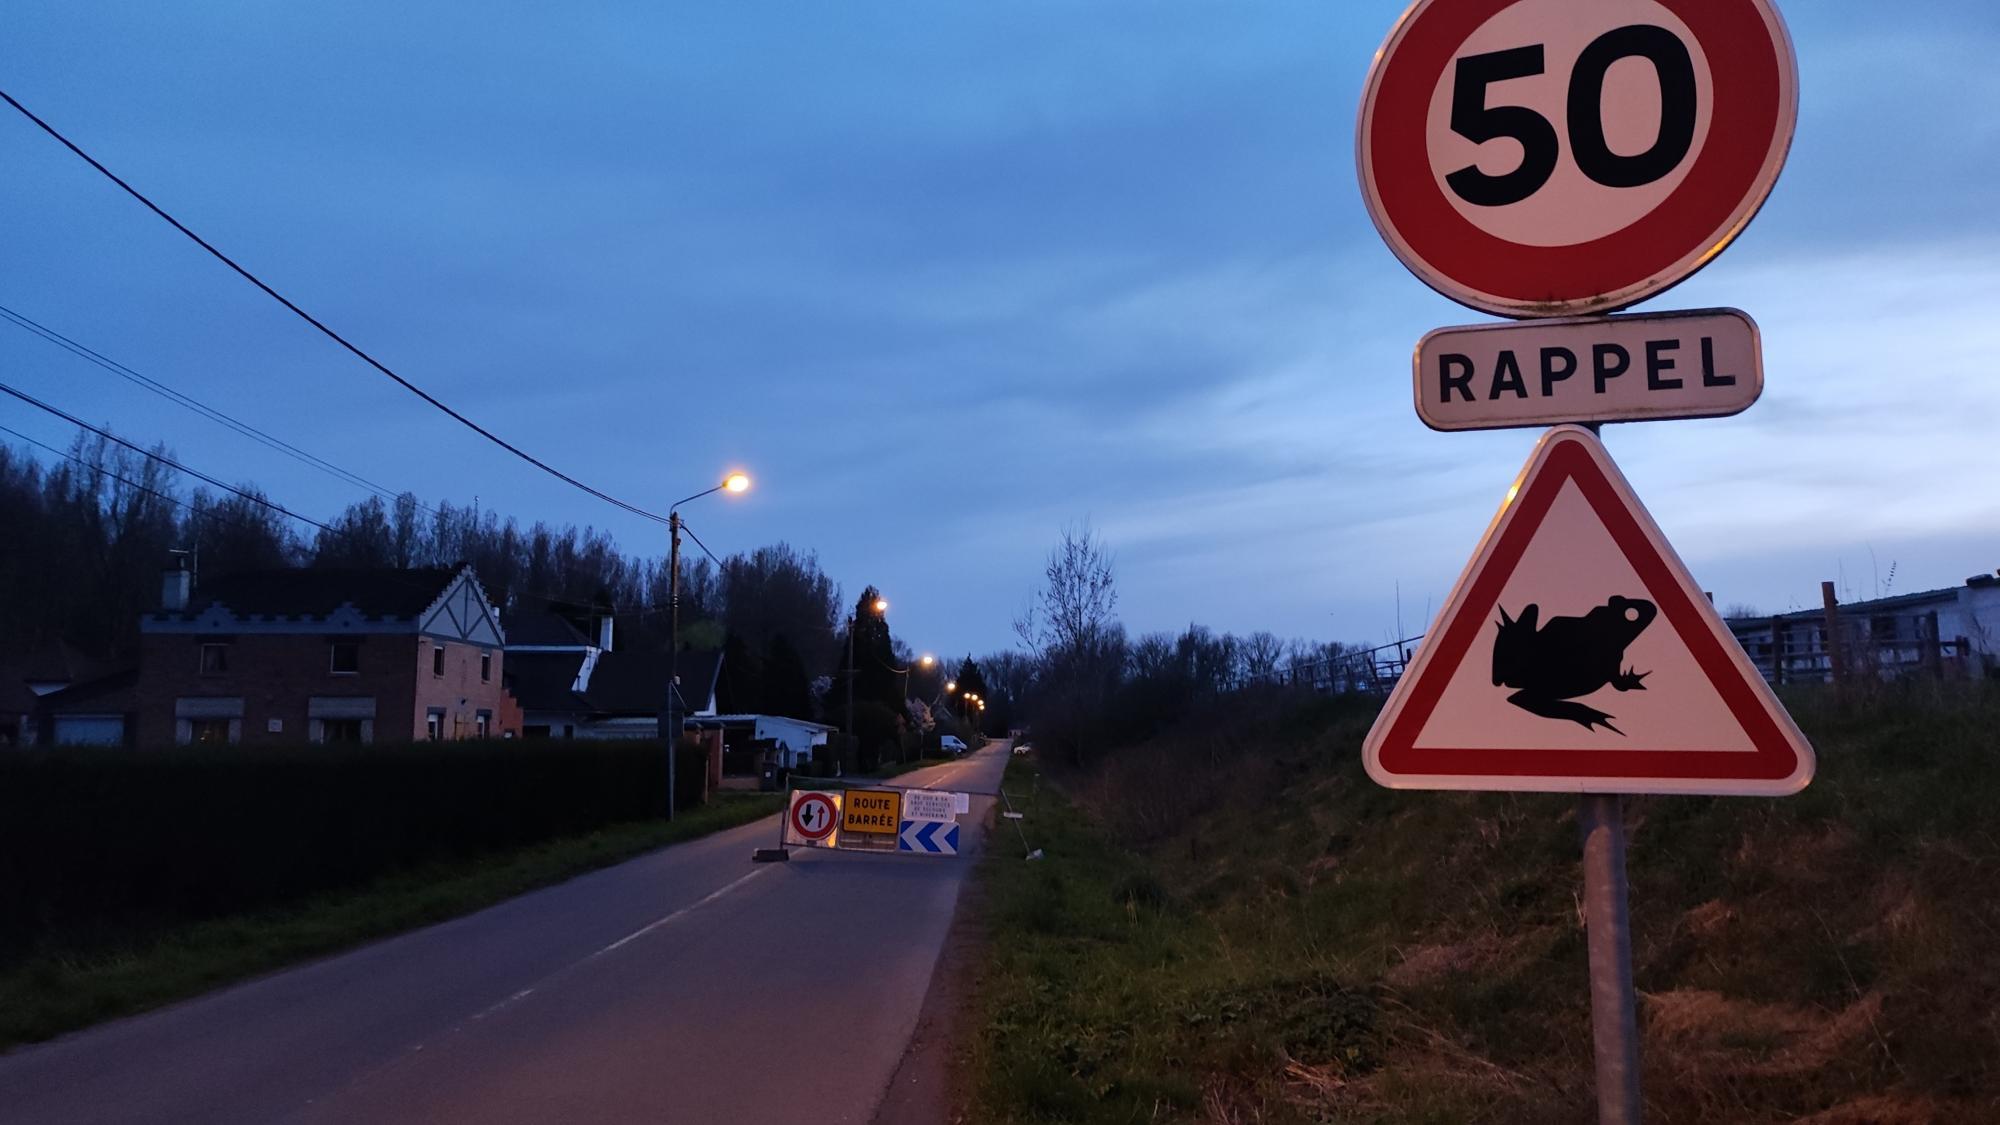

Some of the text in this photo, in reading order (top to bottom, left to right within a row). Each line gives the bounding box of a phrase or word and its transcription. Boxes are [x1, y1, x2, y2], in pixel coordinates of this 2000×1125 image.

[1445, 24, 1697, 207] 50
[1438, 336, 1736, 403] RAPPEL
[848, 814, 893, 826] BARRÉE
[854, 798, 890, 809] ROUTE
